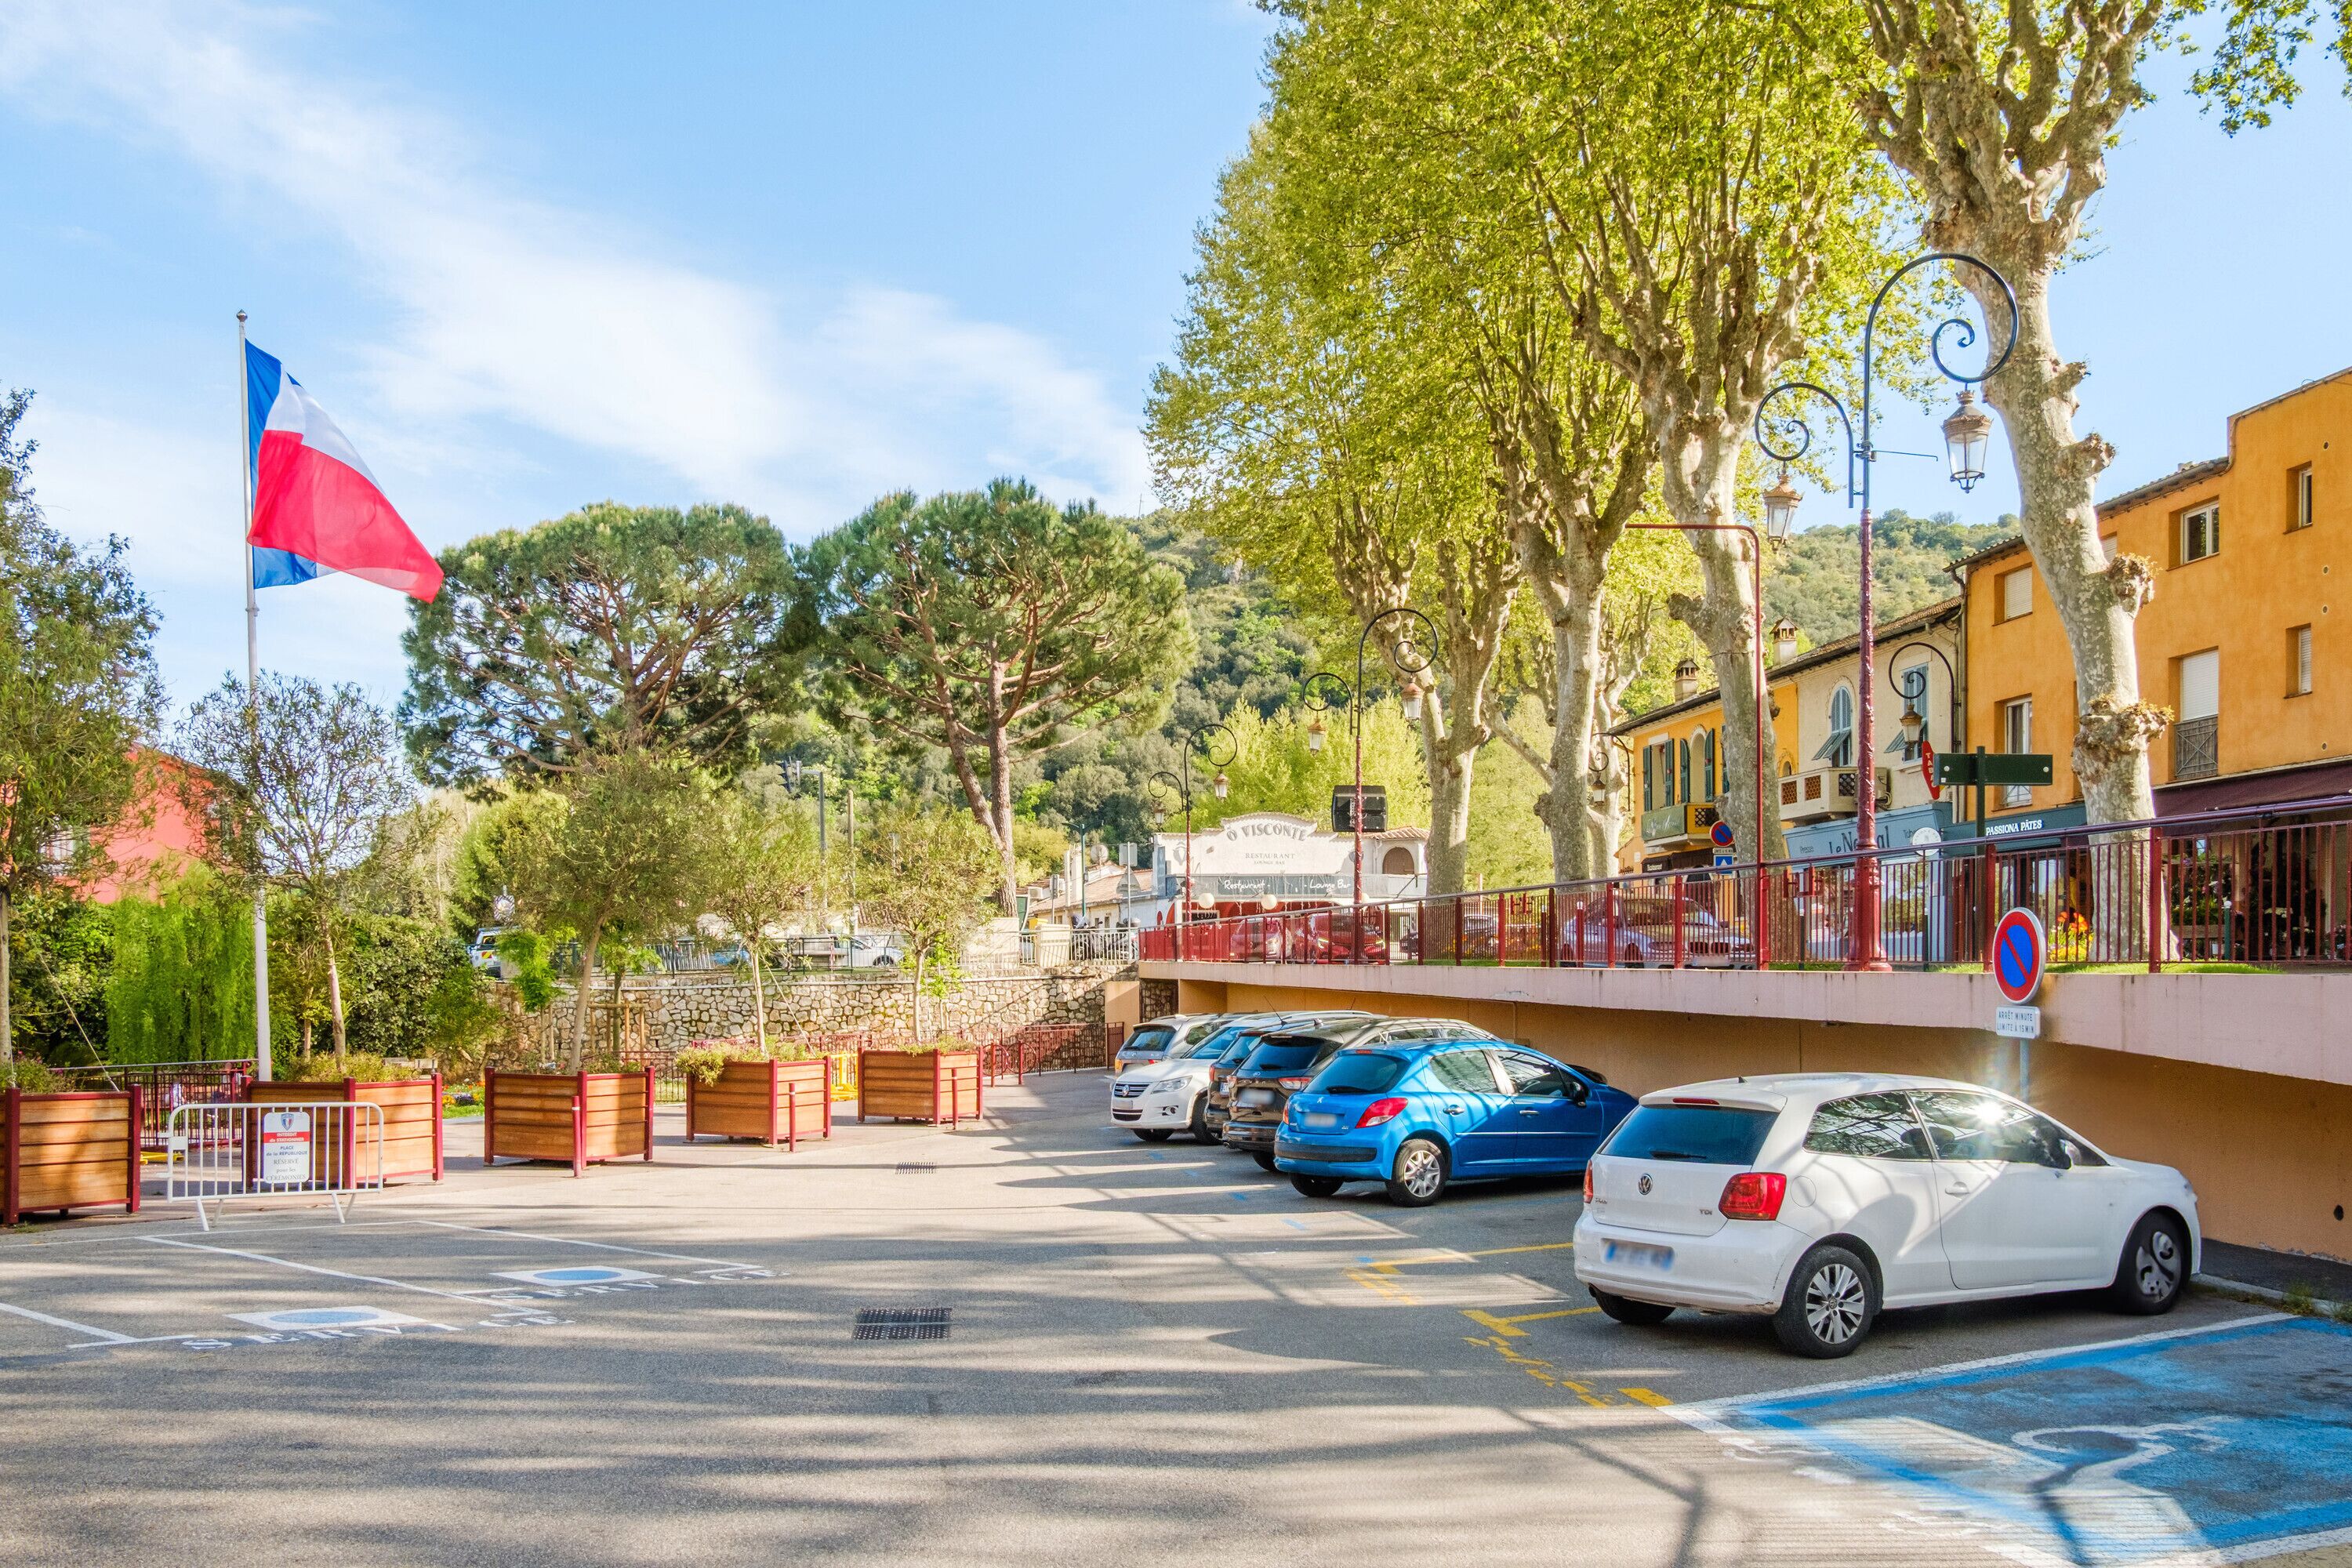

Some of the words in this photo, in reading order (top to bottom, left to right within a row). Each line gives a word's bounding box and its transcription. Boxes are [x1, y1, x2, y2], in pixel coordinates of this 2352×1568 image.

[1241, 822, 1307, 842] VISCONTE
[1985, 822, 2020, 837] PASSIONA
[2020, 819, 2042, 832] PÂTES
[1224, 879, 1266, 893] Restaurant
[1337, 878, 1352, 889] Bar
[1998, 1010, 2013, 1020] ARRÊT
[2015, 1012, 2033, 1022] MINUTE
